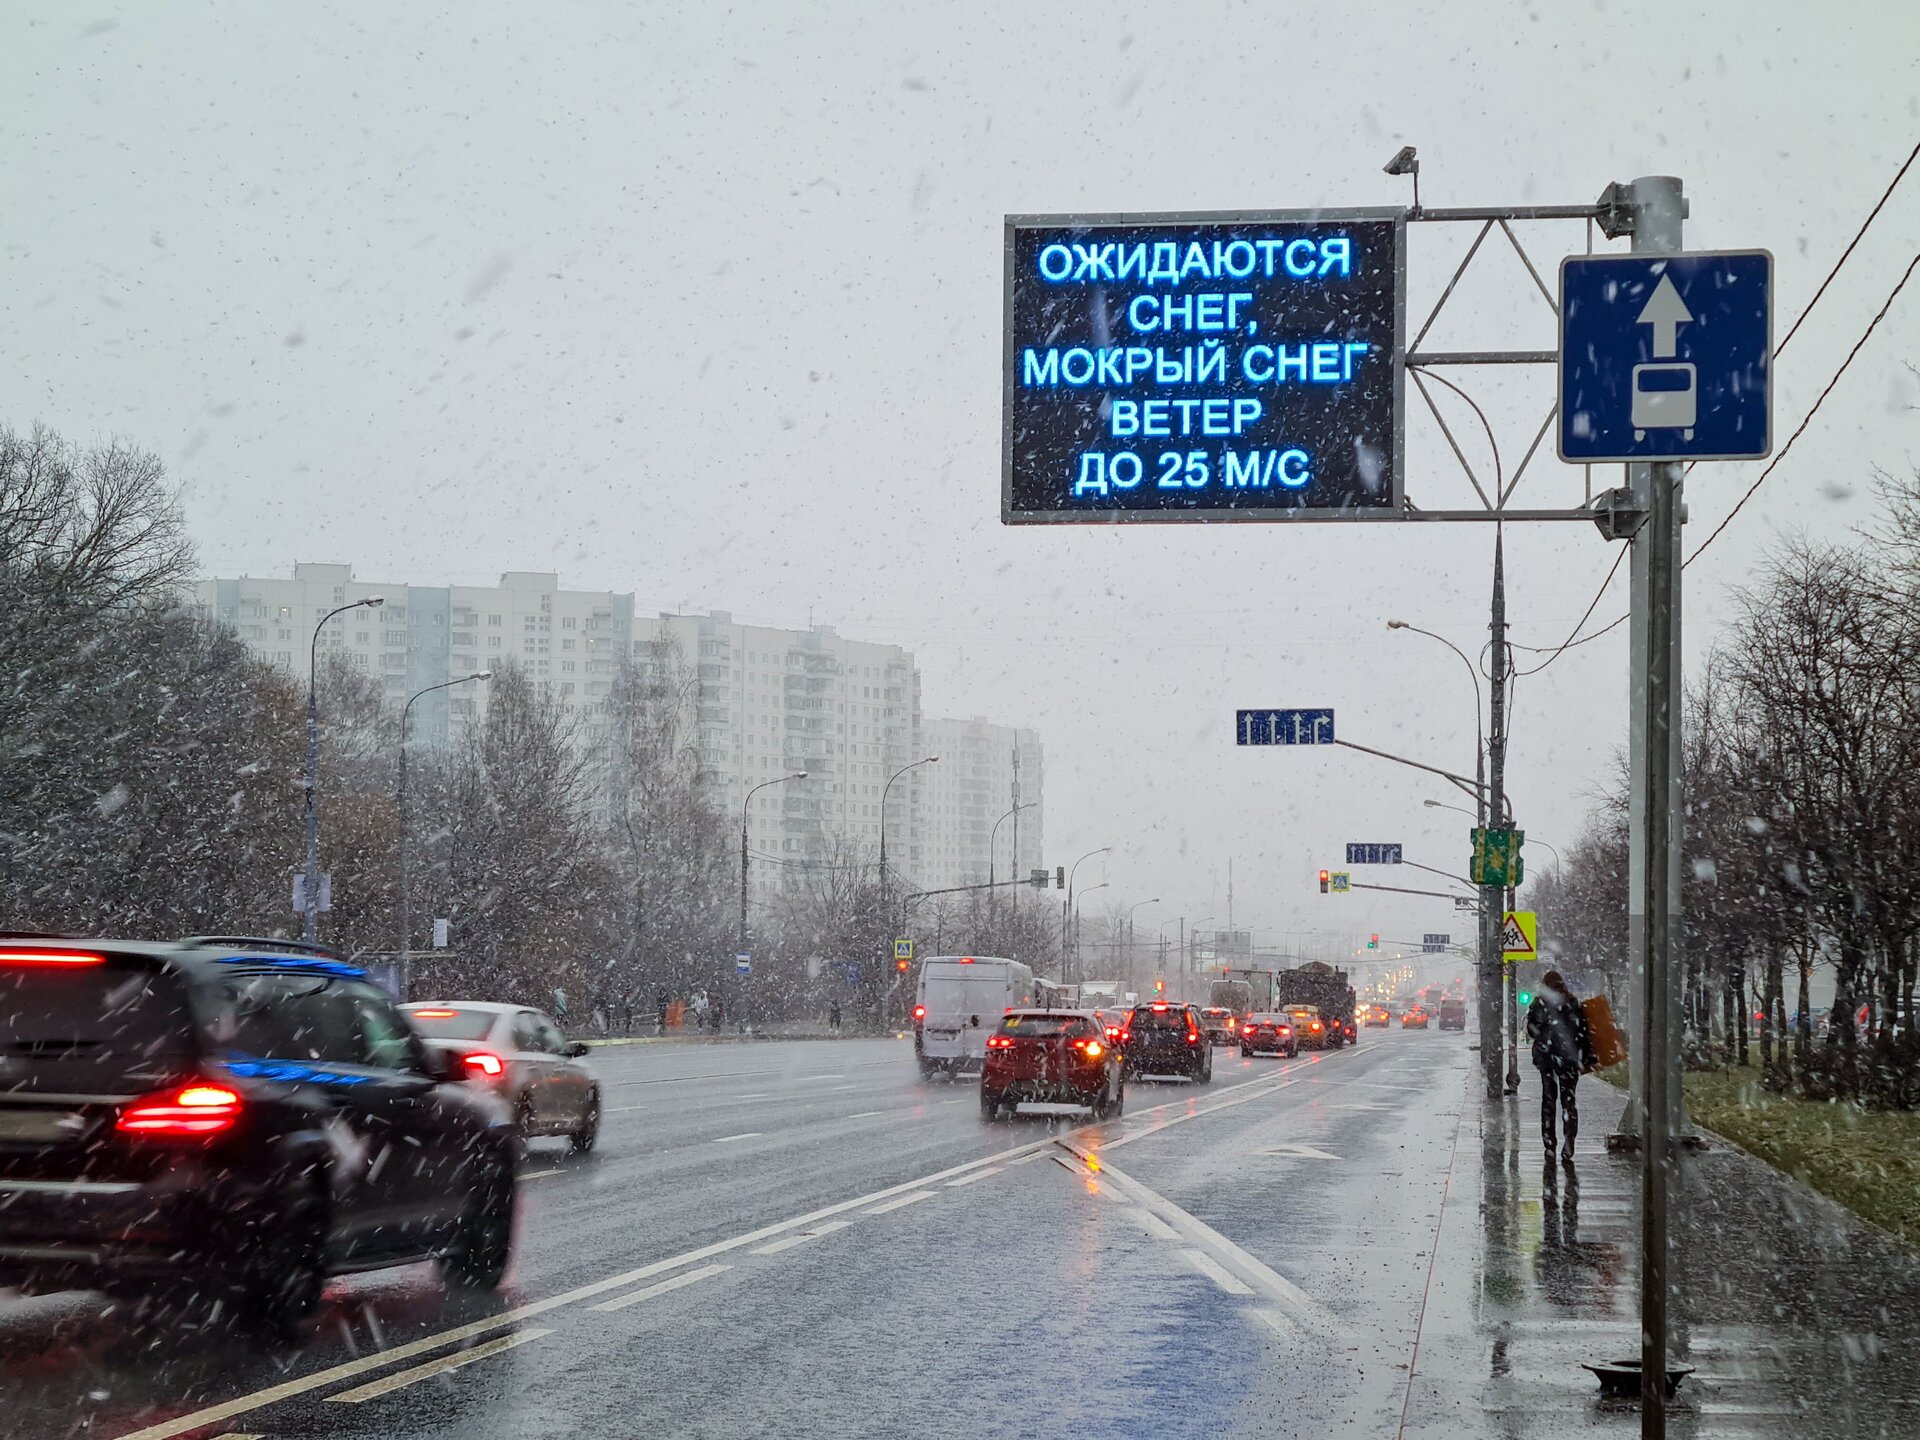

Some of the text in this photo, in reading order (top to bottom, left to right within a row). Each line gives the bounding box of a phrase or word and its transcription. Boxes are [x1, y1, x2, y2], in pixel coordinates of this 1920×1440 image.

[1038, 238, 1351, 286] ОЖИДАЮТСЯ
[1128, 292, 1258, 335] СНЕГ,
[1023, 338, 1369, 385] МОКРЫЙ СНЕГ
[1111, 399, 1263, 437] ВЕТЕР
[1075, 449, 1311, 495] ДО 25 М/С
